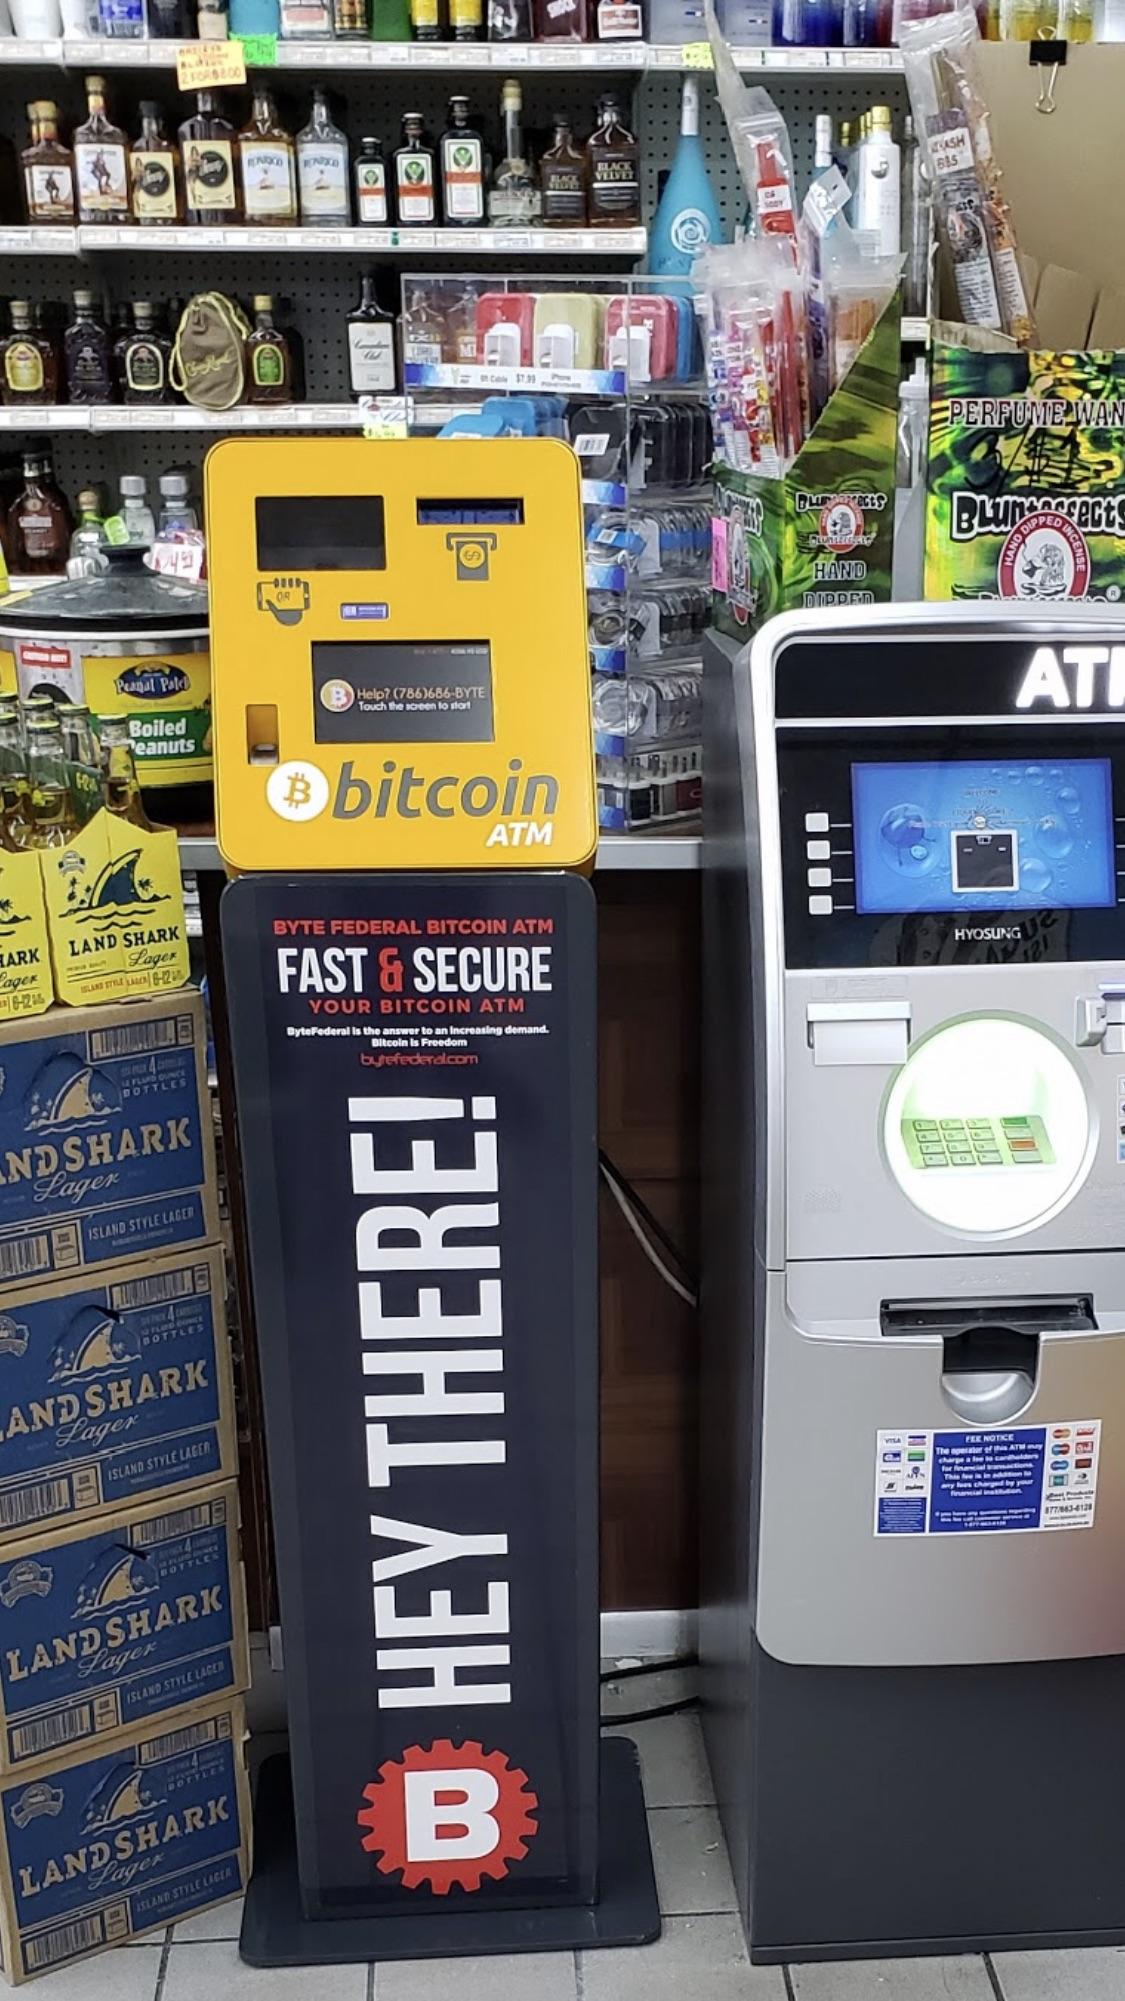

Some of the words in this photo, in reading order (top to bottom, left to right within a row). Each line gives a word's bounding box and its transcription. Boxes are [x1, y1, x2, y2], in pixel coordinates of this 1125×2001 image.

[595, 171, 634, 180] VELVET
[597, 161, 632, 171] BLACK
[949, 398, 1067, 428] PERFUME
[1004, 535, 1024, 567] HAND
[1020, 516, 1063, 538] DIPPED
[1063, 520, 1086, 572] INCENSE
[813, 560, 867, 580] HAND
[115, 678, 155, 695] Peanut
[357, 687, 390, 701] Help?
[393, 686, 485, 700] (786)686-BYTE
[359, 702, 387, 711] Touch
[389, 702, 403, 711] the
[406, 703, 436, 711] screen
[438, 702, 448, 710] to
[450, 701, 471, 710] start
[129, 717, 187, 737] Boiled
[332, 759, 559, 819] bitcoin
[486, 823, 553, 848] ATM
[273, 919, 325, 935] BYTE
[330, 919, 422, 935] FEDERAL
[427, 919, 506, 935] BITCOIN
[512, 918, 553, 934] ATM
[955, 927, 1021, 940] HYOSUNG
[69, 934, 117, 956] LAND
[123, 926, 180, 948] SHARK
[129, 948, 177, 970] Lager
[277, 948, 368, 993] FAST
[379, 947, 403, 993] &
[413, 946, 552, 992] SECURE
[105, 978, 123, 989] STYLE
[309, 999, 371, 1014] YOUR
[380, 999, 471, 1014] BITCOIN
[479, 998, 524, 1013] ATM
[287, 1026, 351, 1037] ByteFederal
[352, 1027, 361, 1036] is
[363, 1026, 381, 1035] the
[382, 1027, 420, 1035] answer
[422, 1026, 433, 1035] to
[434, 1027, 448, 1035] an
[450, 1026, 503, 1037] increasing
[504, 1025, 550, 1035] demand.
[371, 1038, 408, 1047] Bitcoin
[410, 1038, 419, 1047] is
[421, 1037, 467, 1047] Freedom
[360, 1053, 479, 1068] bytefederal.com
[123, 1078, 186, 1098] BOTTLES
[34, 1170, 119, 1203] Lager
[89, 1222, 126, 1240] ISLAND
[129, 1213, 160, 1232] STYLE
[163, 1207, 194, 1225] LAGER
[348, 1095, 507, 1487] THERE!
[143, 1324, 204, 1346] BOTTLES
[56, 1414, 138, 1447] Lager
[965, 1435, 981, 1443] FEE
[983, 1433, 1014, 1442] NOTICE
[936, 1447, 949, 1455] The
[951, 1446, 983, 1456] operator
[984, 1445, 992, 1453] of
[1009, 1443, 1025, 1451] ATM
[1027, 1444, 1043, 1452] may
[938, 1457, 964, 1465] charge
[995, 1454, 1039, 1462] cardholders
[109, 1462, 144, 1481] ISLAND
[147, 1450, 177, 1470] STYLE
[180, 1442, 210, 1460] LAGER
[954, 1464, 985, 1472] financial
[974, 1480, 1004, 1488] charged
[1016, 1479, 1033, 1487] your
[992, 1471, 1022, 1479] addition
[371, 1514, 511, 1709] HEY
[78, 1642, 157, 1678] Lager
[127, 1680, 162, 1704] ISLAND
[163, 1669, 193, 1691] STYLE
[195, 1660, 225, 1681] LAGER
[403, 1767, 500, 1863] B
[88, 1855, 164, 1890] Lager
[137, 1892, 171, 1913] ISLAND
[173, 1880, 201, 1902] STYLE
[203, 1868, 232, 1889] LAGER
